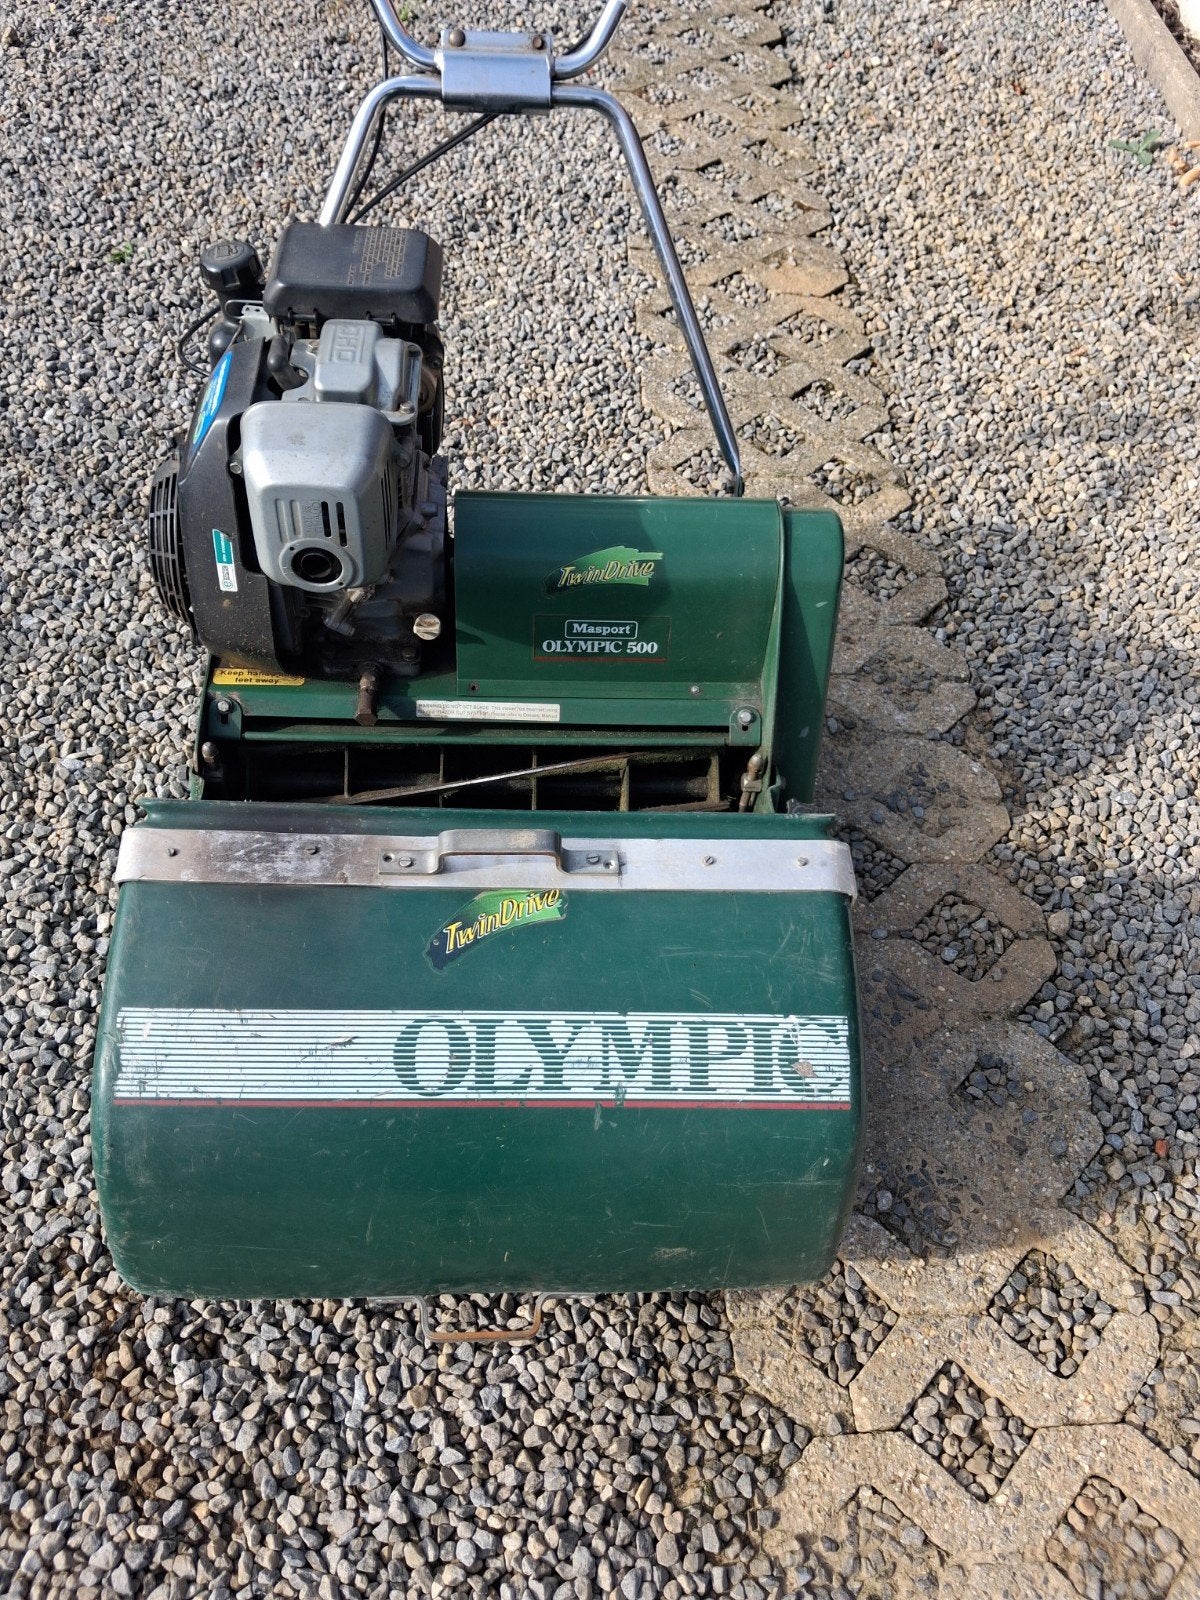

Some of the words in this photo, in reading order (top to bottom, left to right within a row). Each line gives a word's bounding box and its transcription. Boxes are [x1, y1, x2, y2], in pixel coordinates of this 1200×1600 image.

[558, 559, 655, 587] TwinDrive
[572, 623, 631, 636] Masport
[542, 640, 623, 653] OLYMPIC
[626, 641, 658, 654] 500
[220, 669, 244, 677] Keep
[443, 889, 560, 953] TwinDrive
[393, 1015, 841, 1096] OLYMPIC
